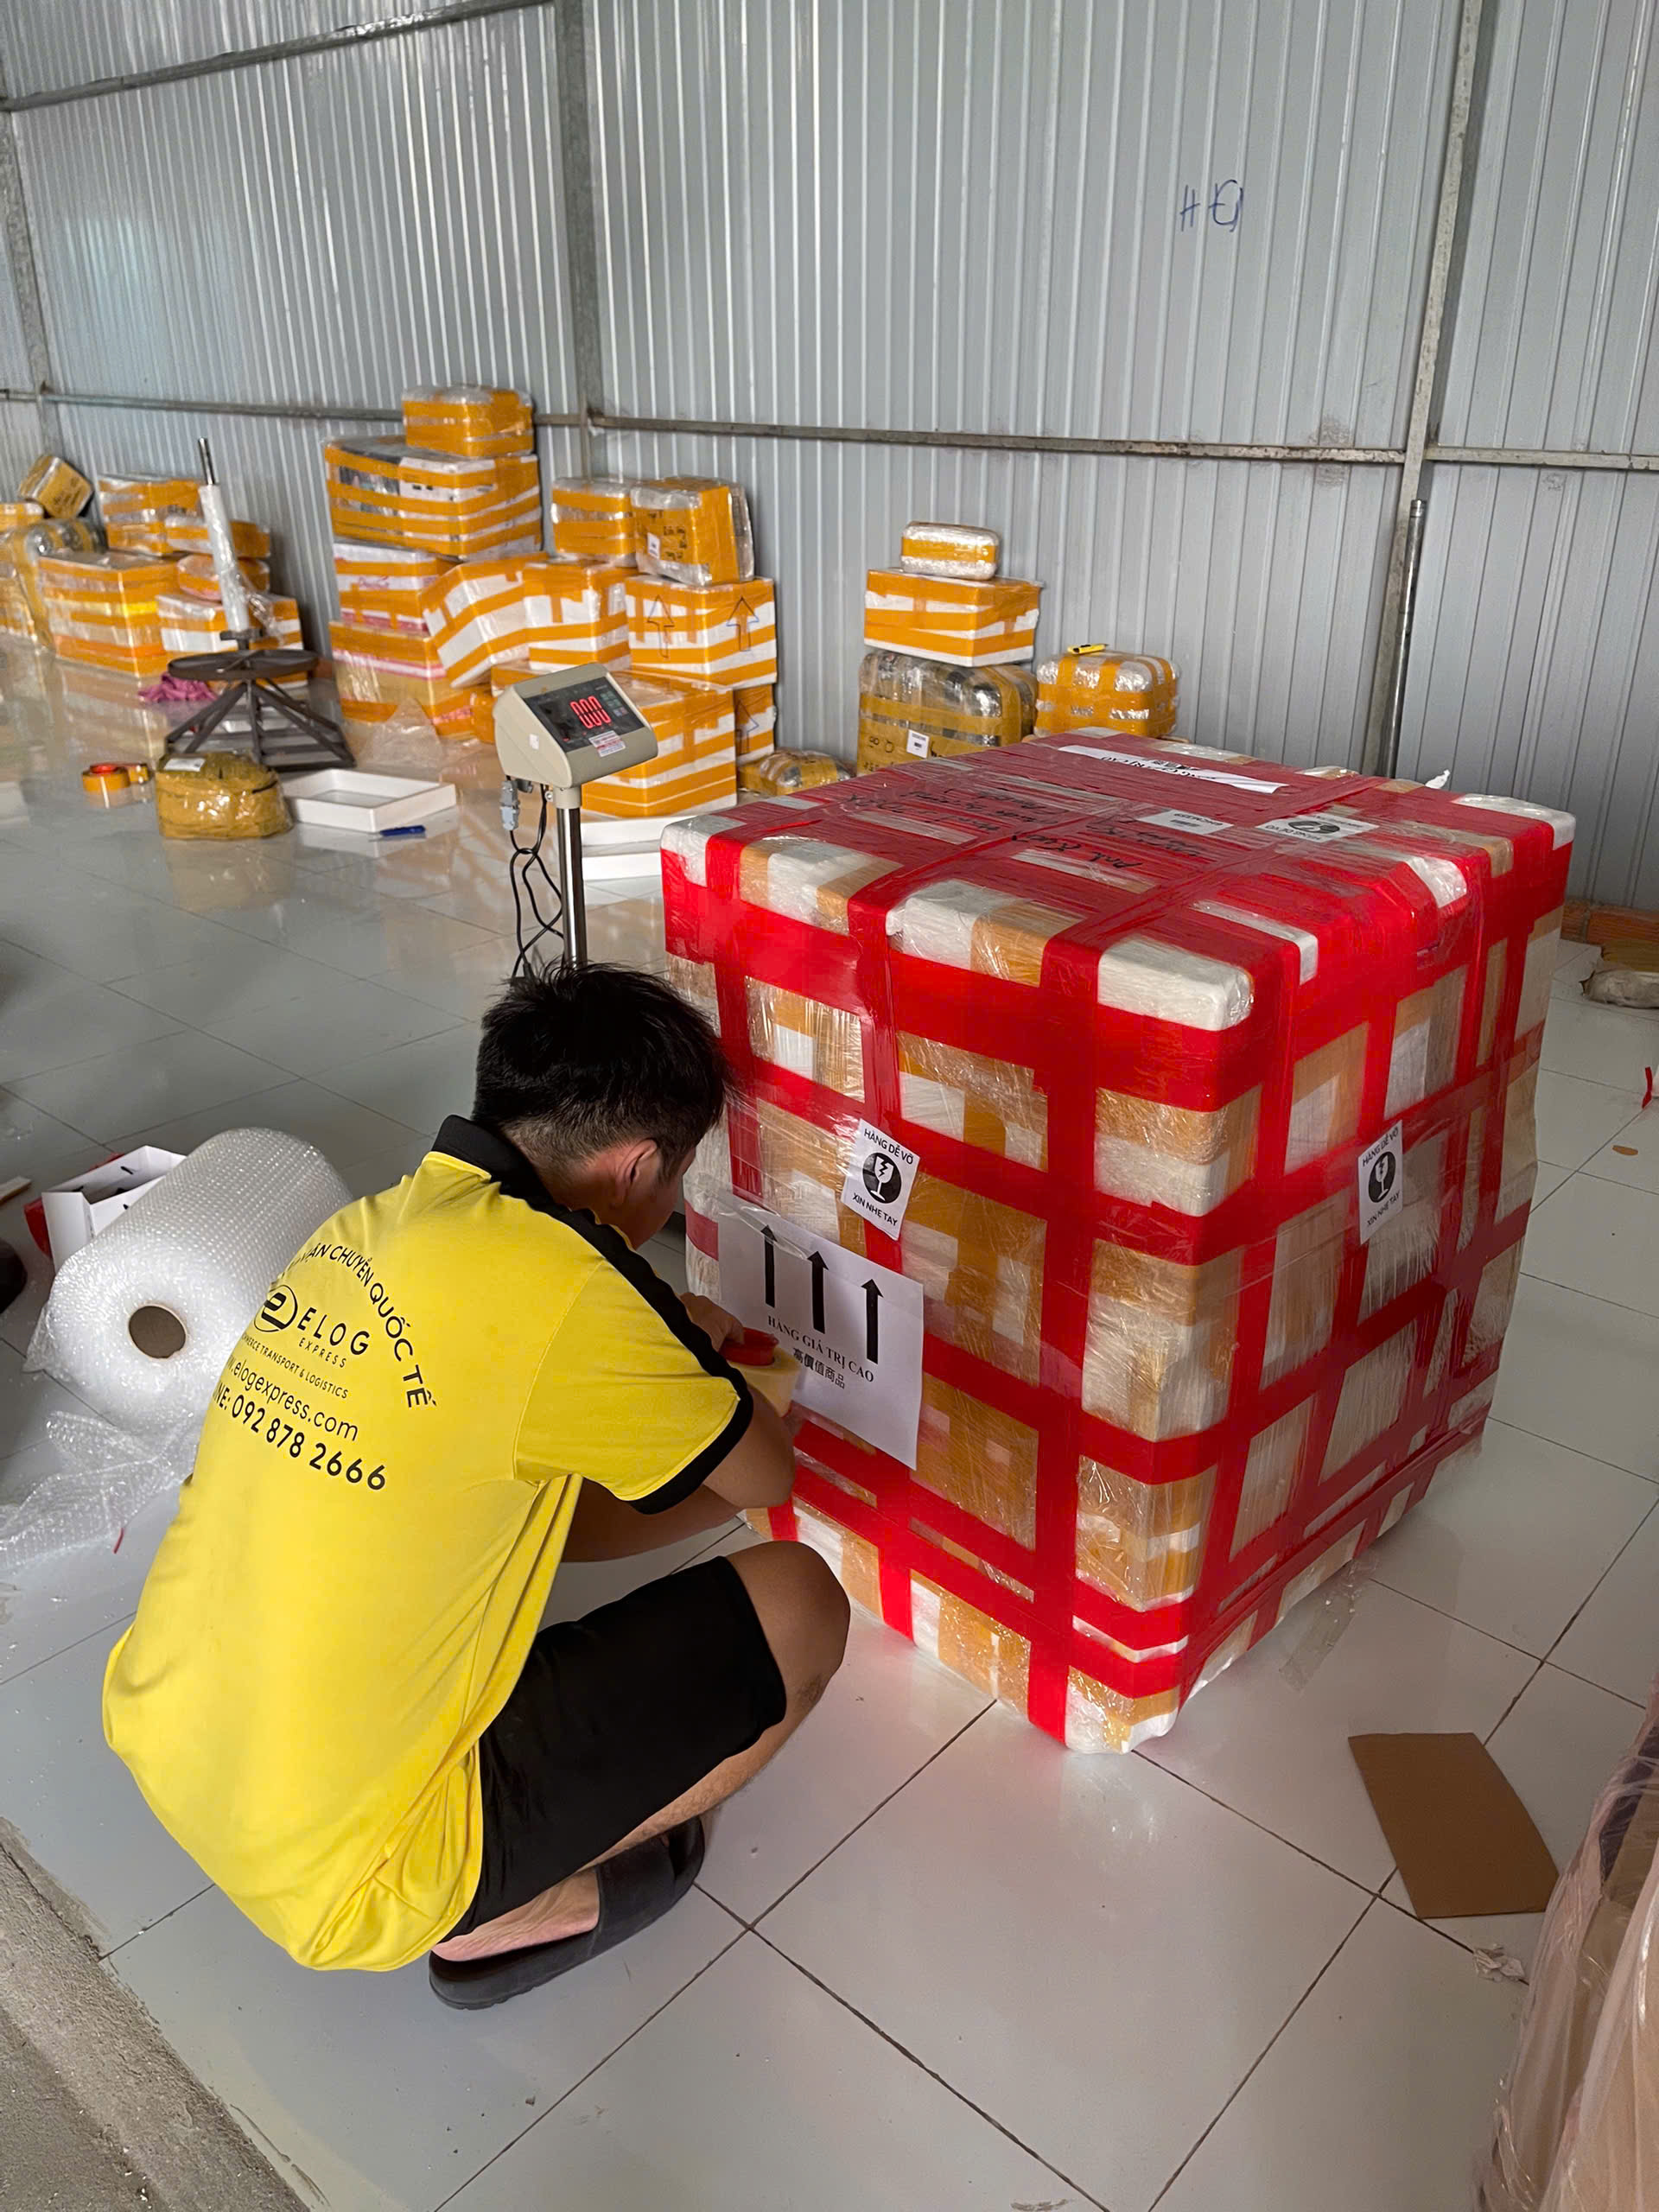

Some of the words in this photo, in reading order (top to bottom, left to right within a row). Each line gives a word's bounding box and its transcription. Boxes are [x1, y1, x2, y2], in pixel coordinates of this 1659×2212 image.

[864, 1128, 887, 1150] HÀNG
[888, 1143, 900, 1158] DỄ
[901, 1150, 914, 1165] VỠ
[852, 1192, 865, 1207] XIN
[883, 1211, 899, 1226] TAY
[296, 1306, 371, 1356] ELOG
[298, 1337, 347, 1368] EXPRESS
[329, 1245, 374, 1287] CHUYỂN
[369, 1282, 413, 1362] QUỐC
[403, 1363, 437, 1408] TẾ
[767, 1314, 800, 1341] HÀNG
[802, 1334, 823, 1355] GIÁ
[826, 1346, 845, 1370] TRỊ
[848, 1360, 874, 1382] CAO
[260, 1344, 300, 1374] TRANSPORT
[305, 1371, 349, 1399] LOGISTICS
[231, 1394, 265, 1433] 092
[266, 1417, 305, 1459] 878
[308, 1442, 386, 1491] 2666
